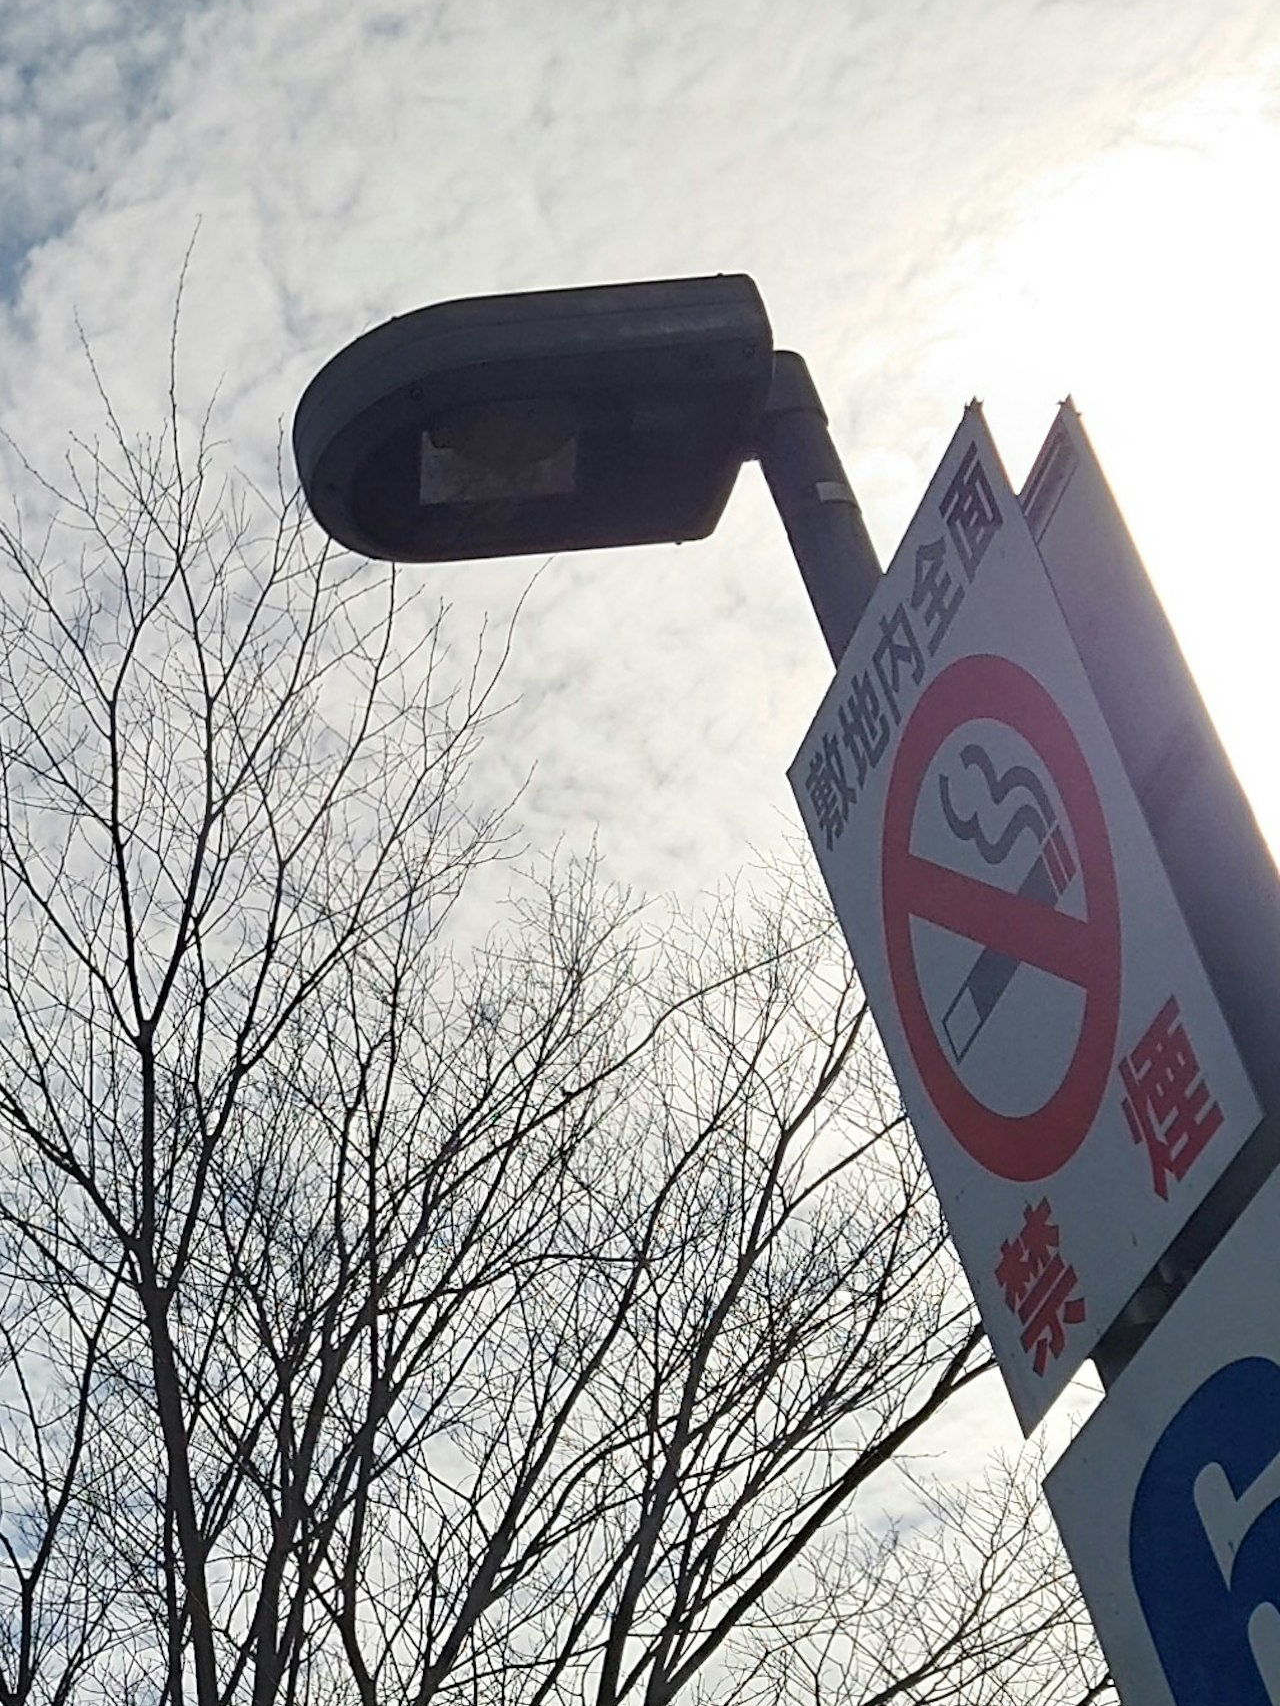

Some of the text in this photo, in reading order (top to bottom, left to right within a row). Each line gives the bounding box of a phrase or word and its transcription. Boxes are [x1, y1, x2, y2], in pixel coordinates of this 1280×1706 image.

[803, 440, 1004, 851] 敷地内全面
